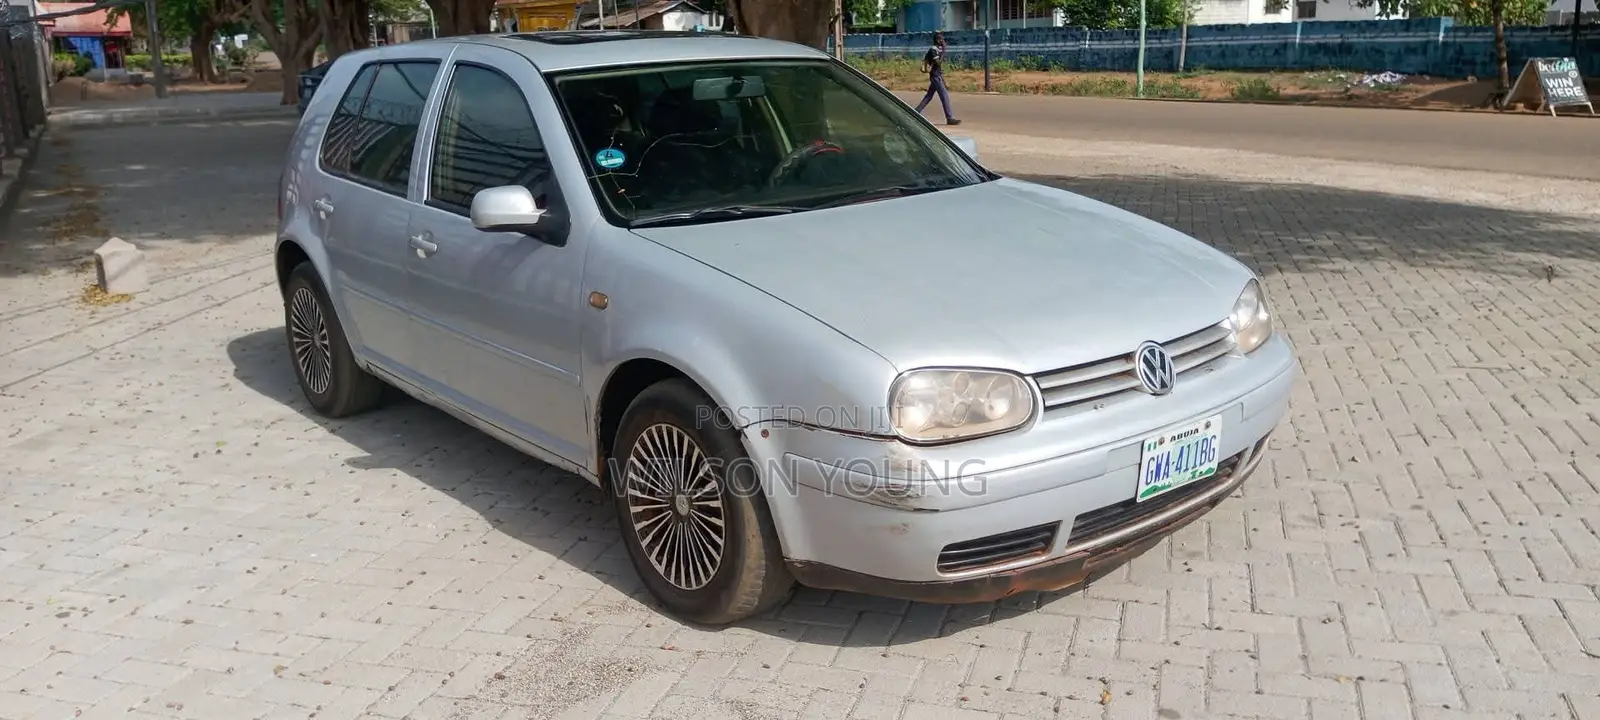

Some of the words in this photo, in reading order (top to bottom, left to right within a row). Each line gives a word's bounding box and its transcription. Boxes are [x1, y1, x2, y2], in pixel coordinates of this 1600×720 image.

[1545, 76, 1574, 88] WIN
[1547, 86, 1583, 98] HERE
[1170, 428, 1199, 442] ABUJA
